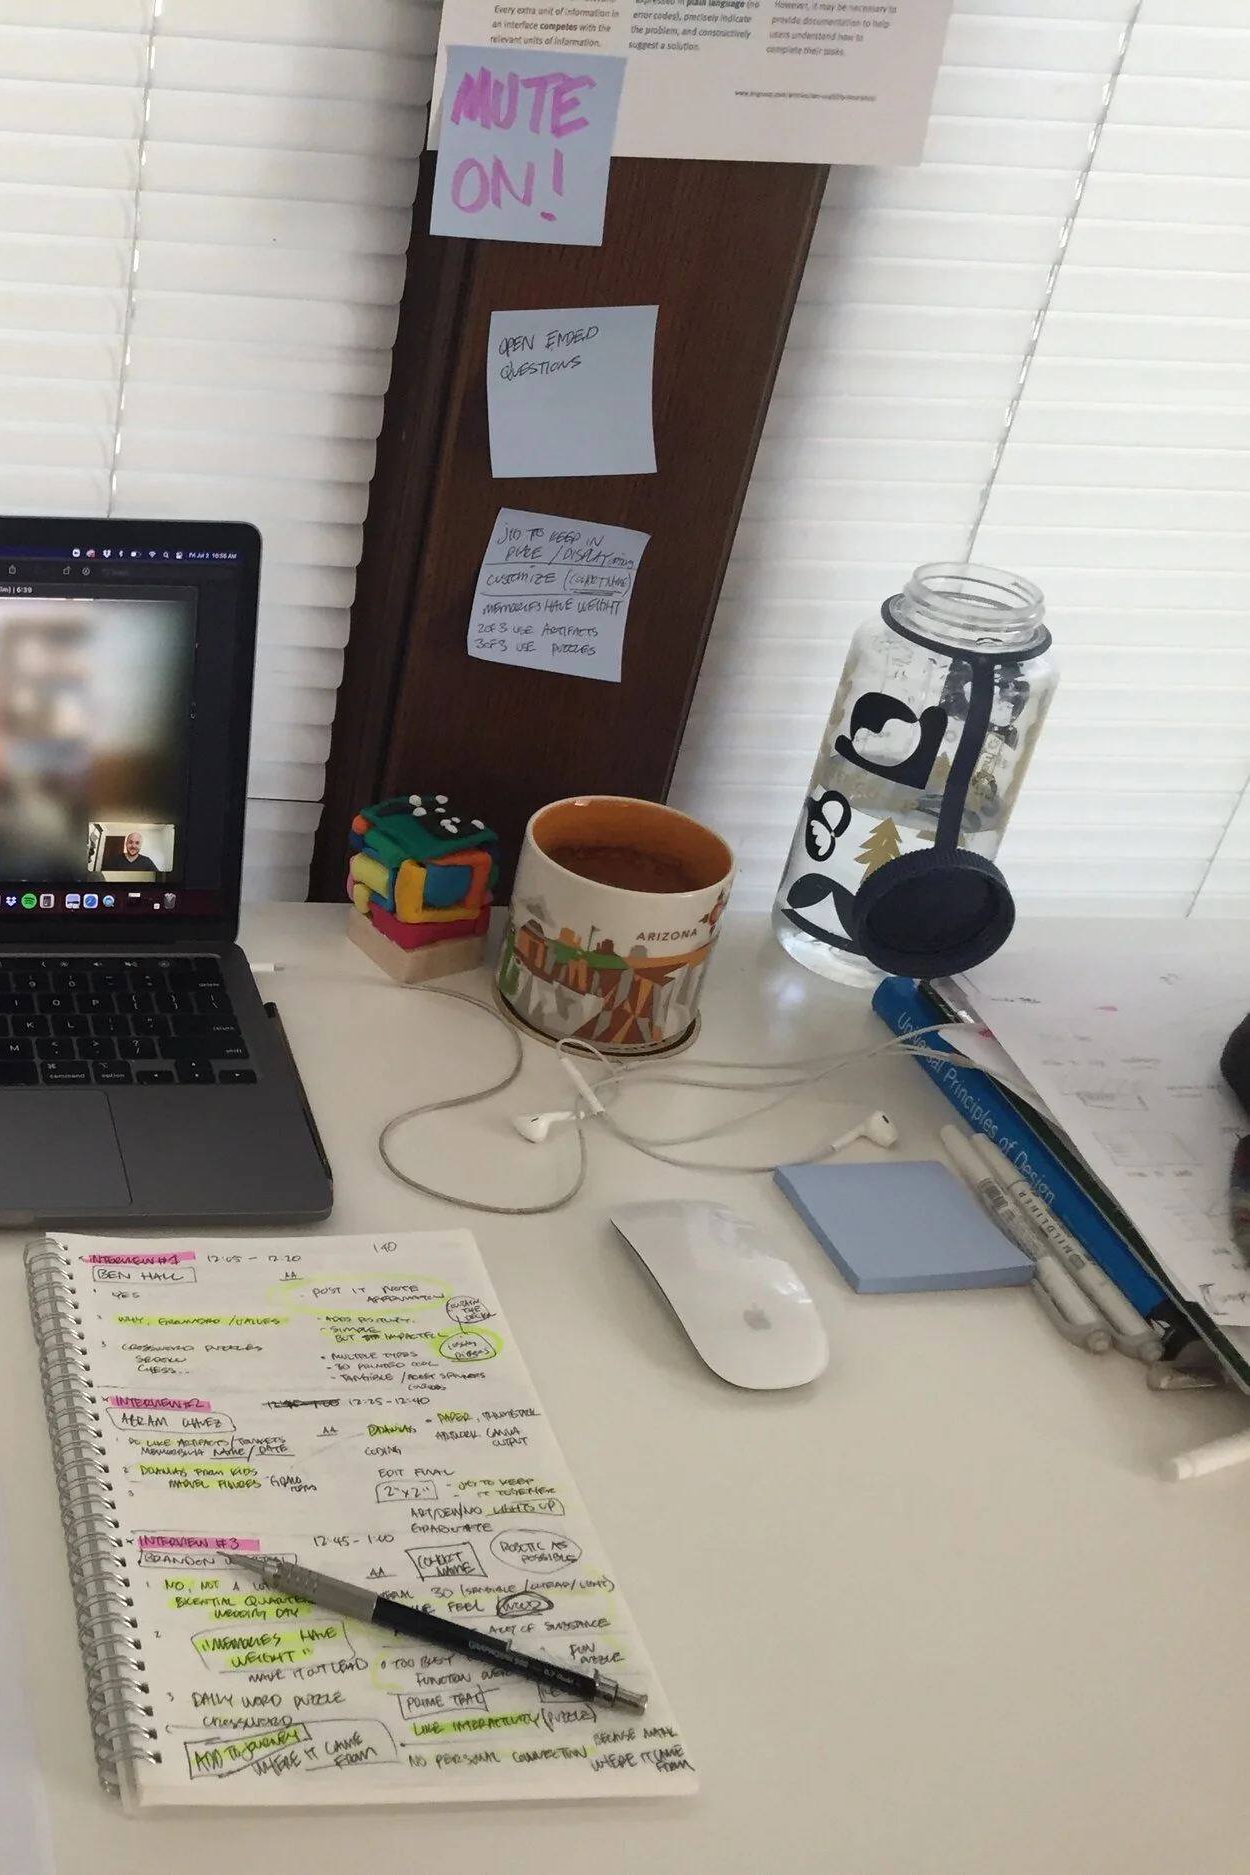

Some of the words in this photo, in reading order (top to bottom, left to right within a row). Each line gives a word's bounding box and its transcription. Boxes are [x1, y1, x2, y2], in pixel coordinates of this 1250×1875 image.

[494, 5, 515, 17] Every
[517, 7, 537, 16] extra
[538, 7, 554, 16] unit
[565, 8, 610, 18] information
[633, 12, 652, 20] error
[684, 14, 719, 25] precisely
[721, 15, 752, 24] indicate
[504, 20, 538, 30] interface
[540, 22, 578, 33] competes
[579, 23, 597, 32] with
[598, 24, 611, 33] the
[630, 26, 644, 35] the
[681, 27, 697, 37] and
[698, 28, 751, 40] constructively
[490, 35, 523, 44] relevant
[524, 35, 543, 45] units
[544, 36, 554, 45] of
[628, 40, 660, 51] suggest
[450, 65, 596, 138] MUTE
[499, 333, 535, 356] OPEN
[545, 326, 599, 352] ENDED
[500, 357, 582, 381] QUESTIONS
[636, 928, 698, 942] ARIZONA
[943, 1067, 999, 1139] Principles
[999, 1136, 1016, 1155] of
[1014, 1150, 1055, 1204] Design
[97, 1268, 131, 1280] BEN
[378, 1468, 403, 1478] EDIT
[242, 1694, 283, 1707] WORD
[294, 1692, 347, 1710] PUZZLE
[409, 1754, 428, 1768] NO
[435, 1753, 501, 1769] PERSONAL
